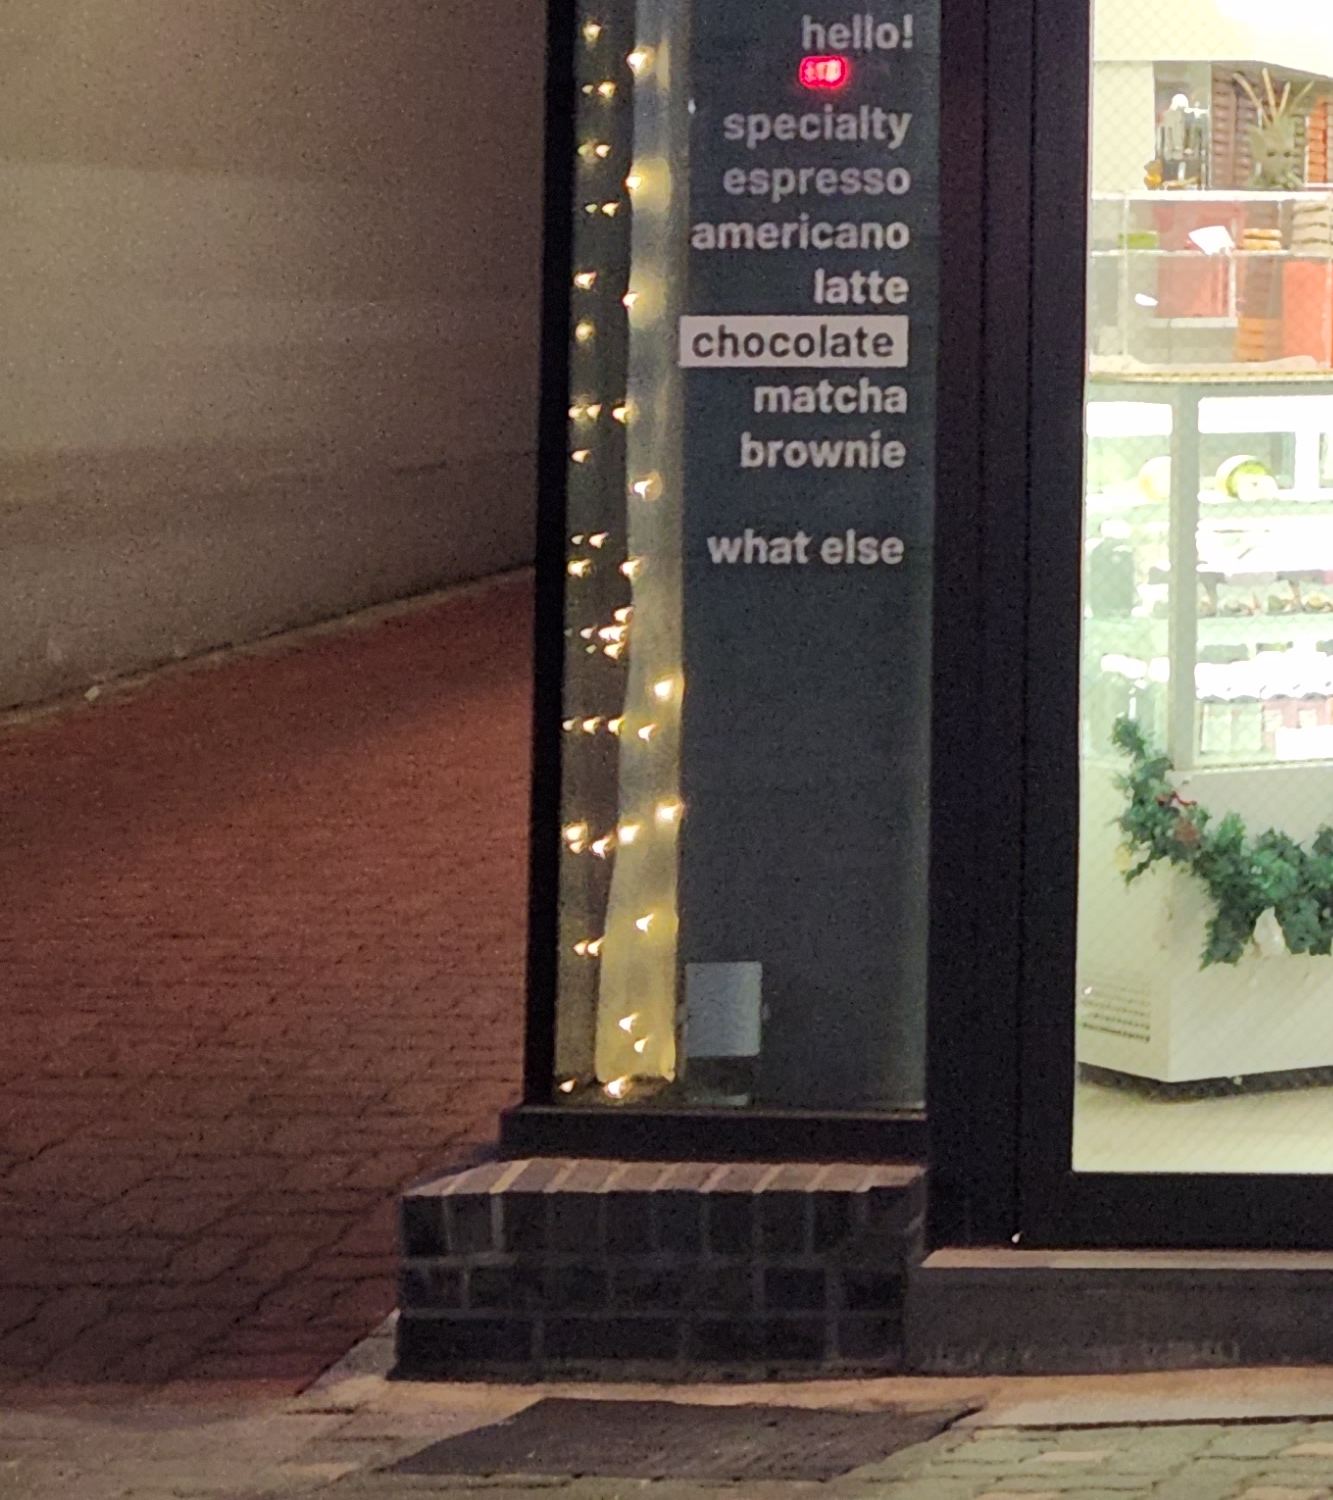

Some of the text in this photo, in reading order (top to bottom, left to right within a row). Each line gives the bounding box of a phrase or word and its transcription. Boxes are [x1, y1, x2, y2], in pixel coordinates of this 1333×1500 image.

[801, 14, 913, 50] hello!
[722, 107, 912, 150] specialty
[722, 165, 911, 203] espresso
[690, 215, 911, 251] americano
[814, 269, 909, 306] latte
[691, 324, 895, 359] chocolate
[753, 379, 907, 415] matcha
[740, 431, 906, 469] brownie
[707, 528, 905, 566] what else
